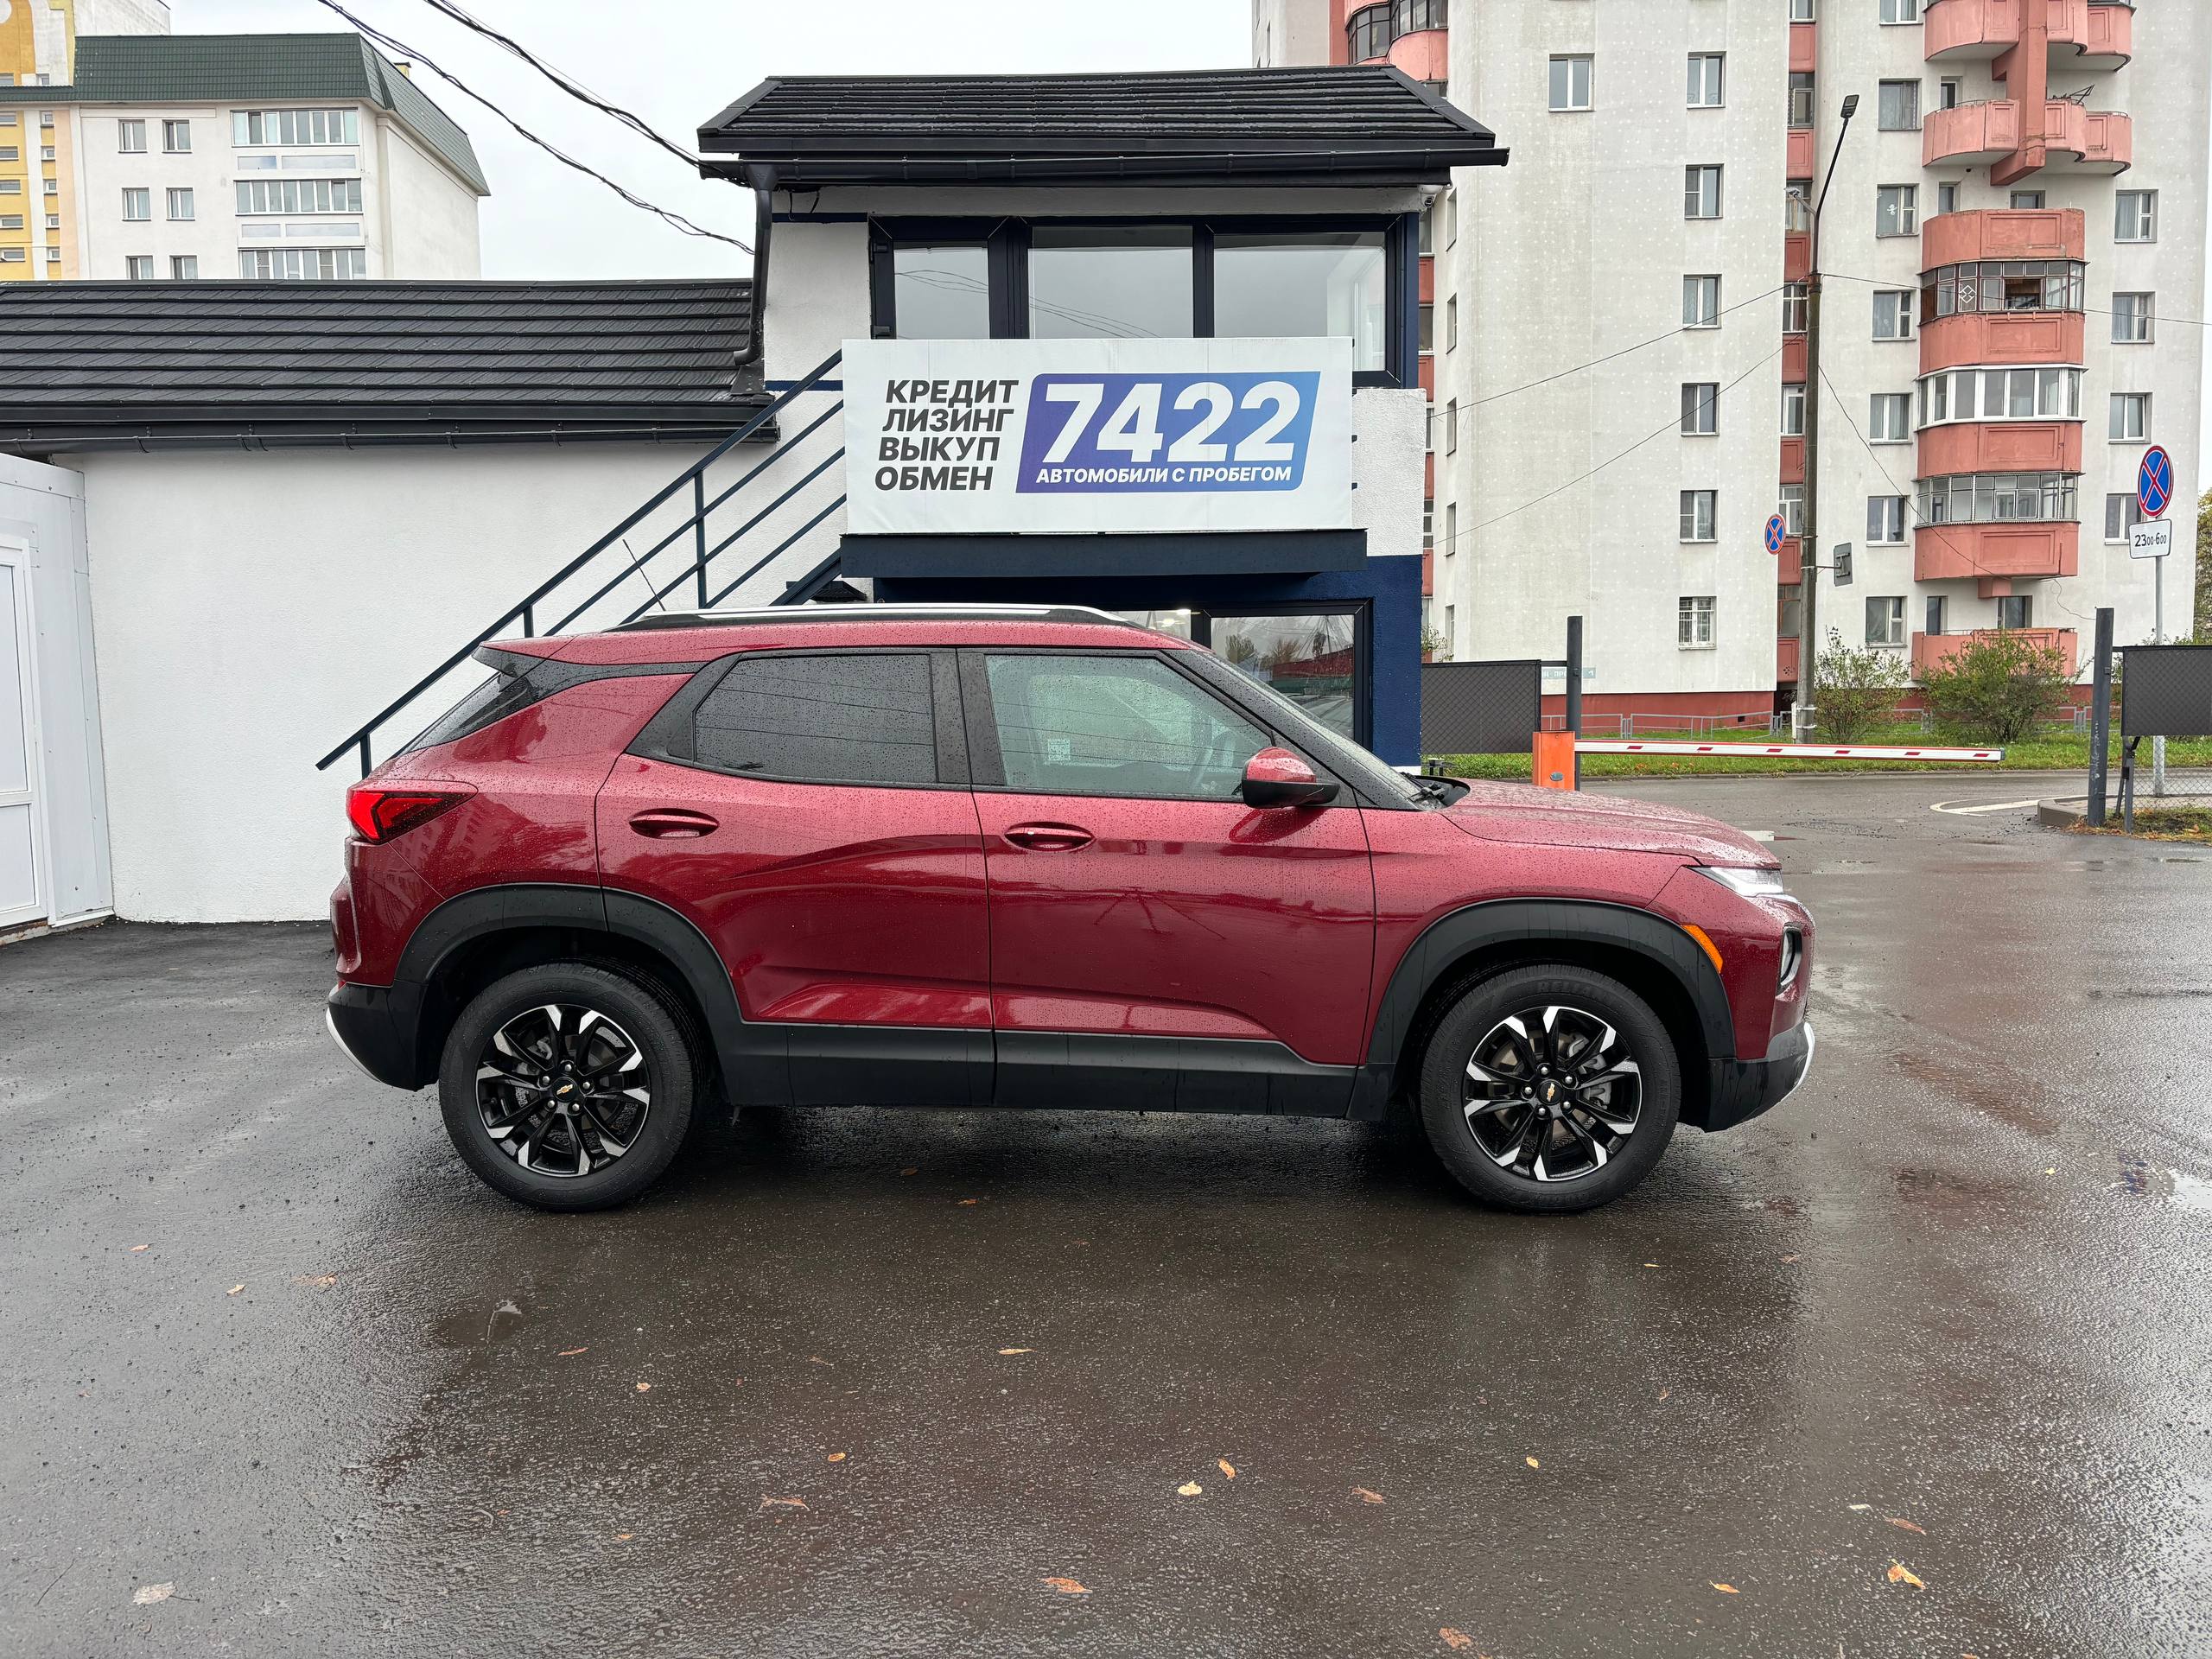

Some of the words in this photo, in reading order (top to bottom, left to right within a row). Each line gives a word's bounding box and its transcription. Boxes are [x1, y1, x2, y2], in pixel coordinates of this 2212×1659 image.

[886, 379, 1019, 408] КРЕДИТ
[881, 409, 1014, 432] ЛИЗИНГ
[1043, 381, 1300, 462] 7422
[878, 436, 1001, 461] ВЫКУП
[874, 466, 994, 491] ОБМЕН
[1035, 467, 1168, 483] АВТОМОБИЛИ
[1172, 467, 1185, 483] С
[1188, 466, 1292, 482] ПРОБЕГОМ
